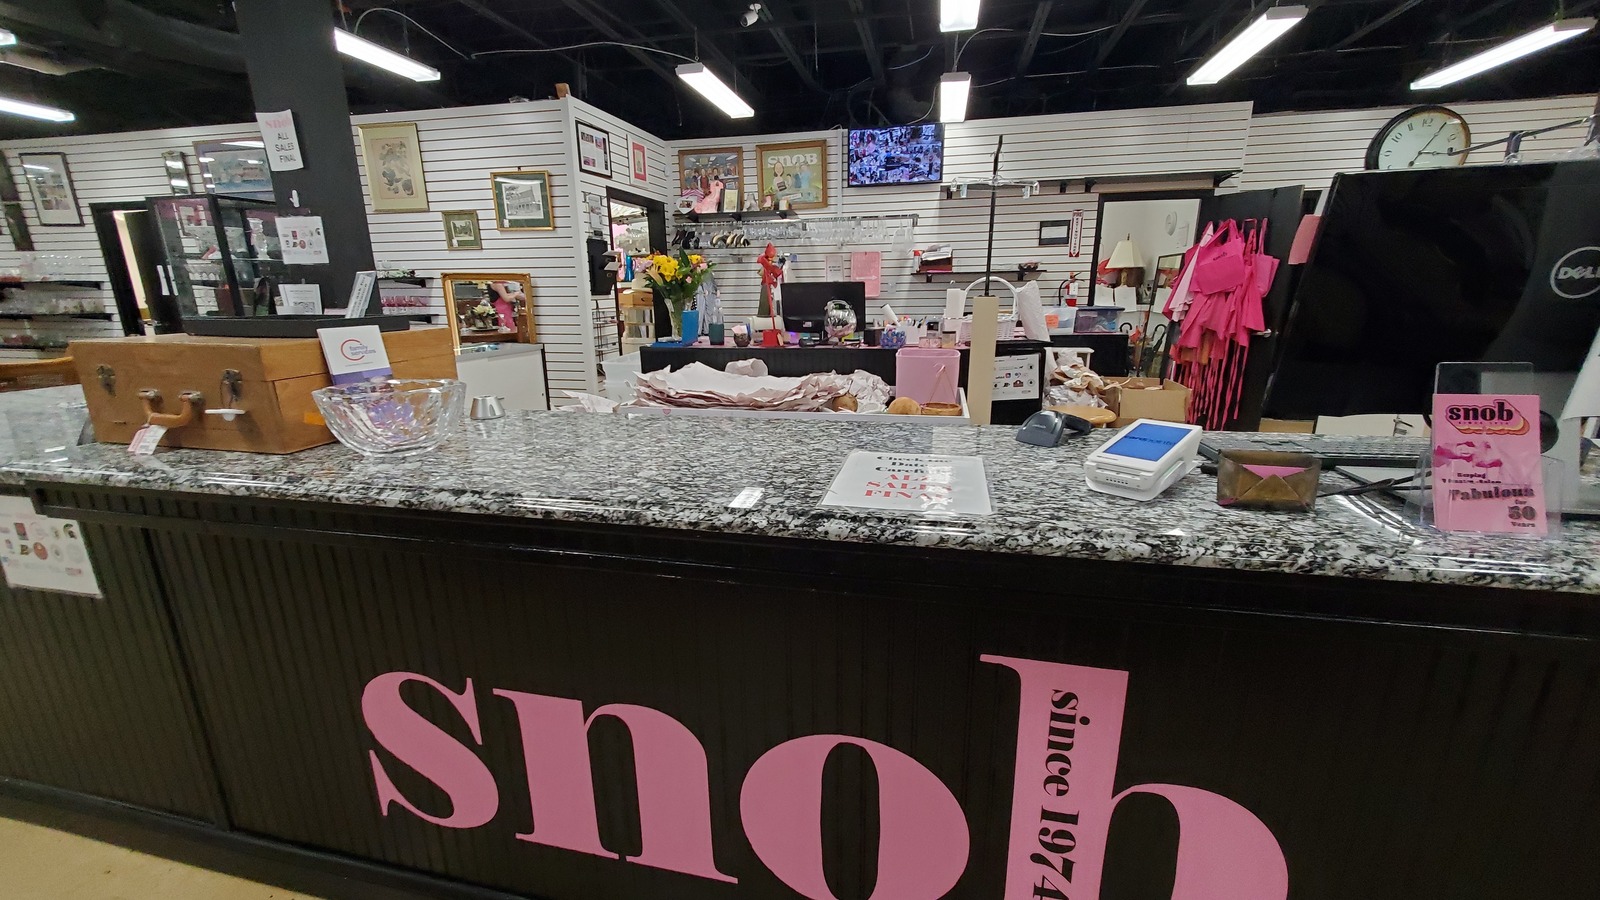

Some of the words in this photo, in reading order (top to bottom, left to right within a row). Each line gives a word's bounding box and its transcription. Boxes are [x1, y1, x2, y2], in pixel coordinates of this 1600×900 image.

[277, 132, 289, 140] ALL
[1391, 132, 1403, 143] 10
[275, 142, 295, 152] SALES
[279, 153, 297, 163] FINAL
[1448, 402, 1514, 421] snob
[1448, 486, 1535, 501] Fabulous
[1508, 505, 1536, 520] 50
[1043, 689, 1090, 797] since
[361, 653, 1289, 900] snob
[1030, 805, 1080, 900] 1974
